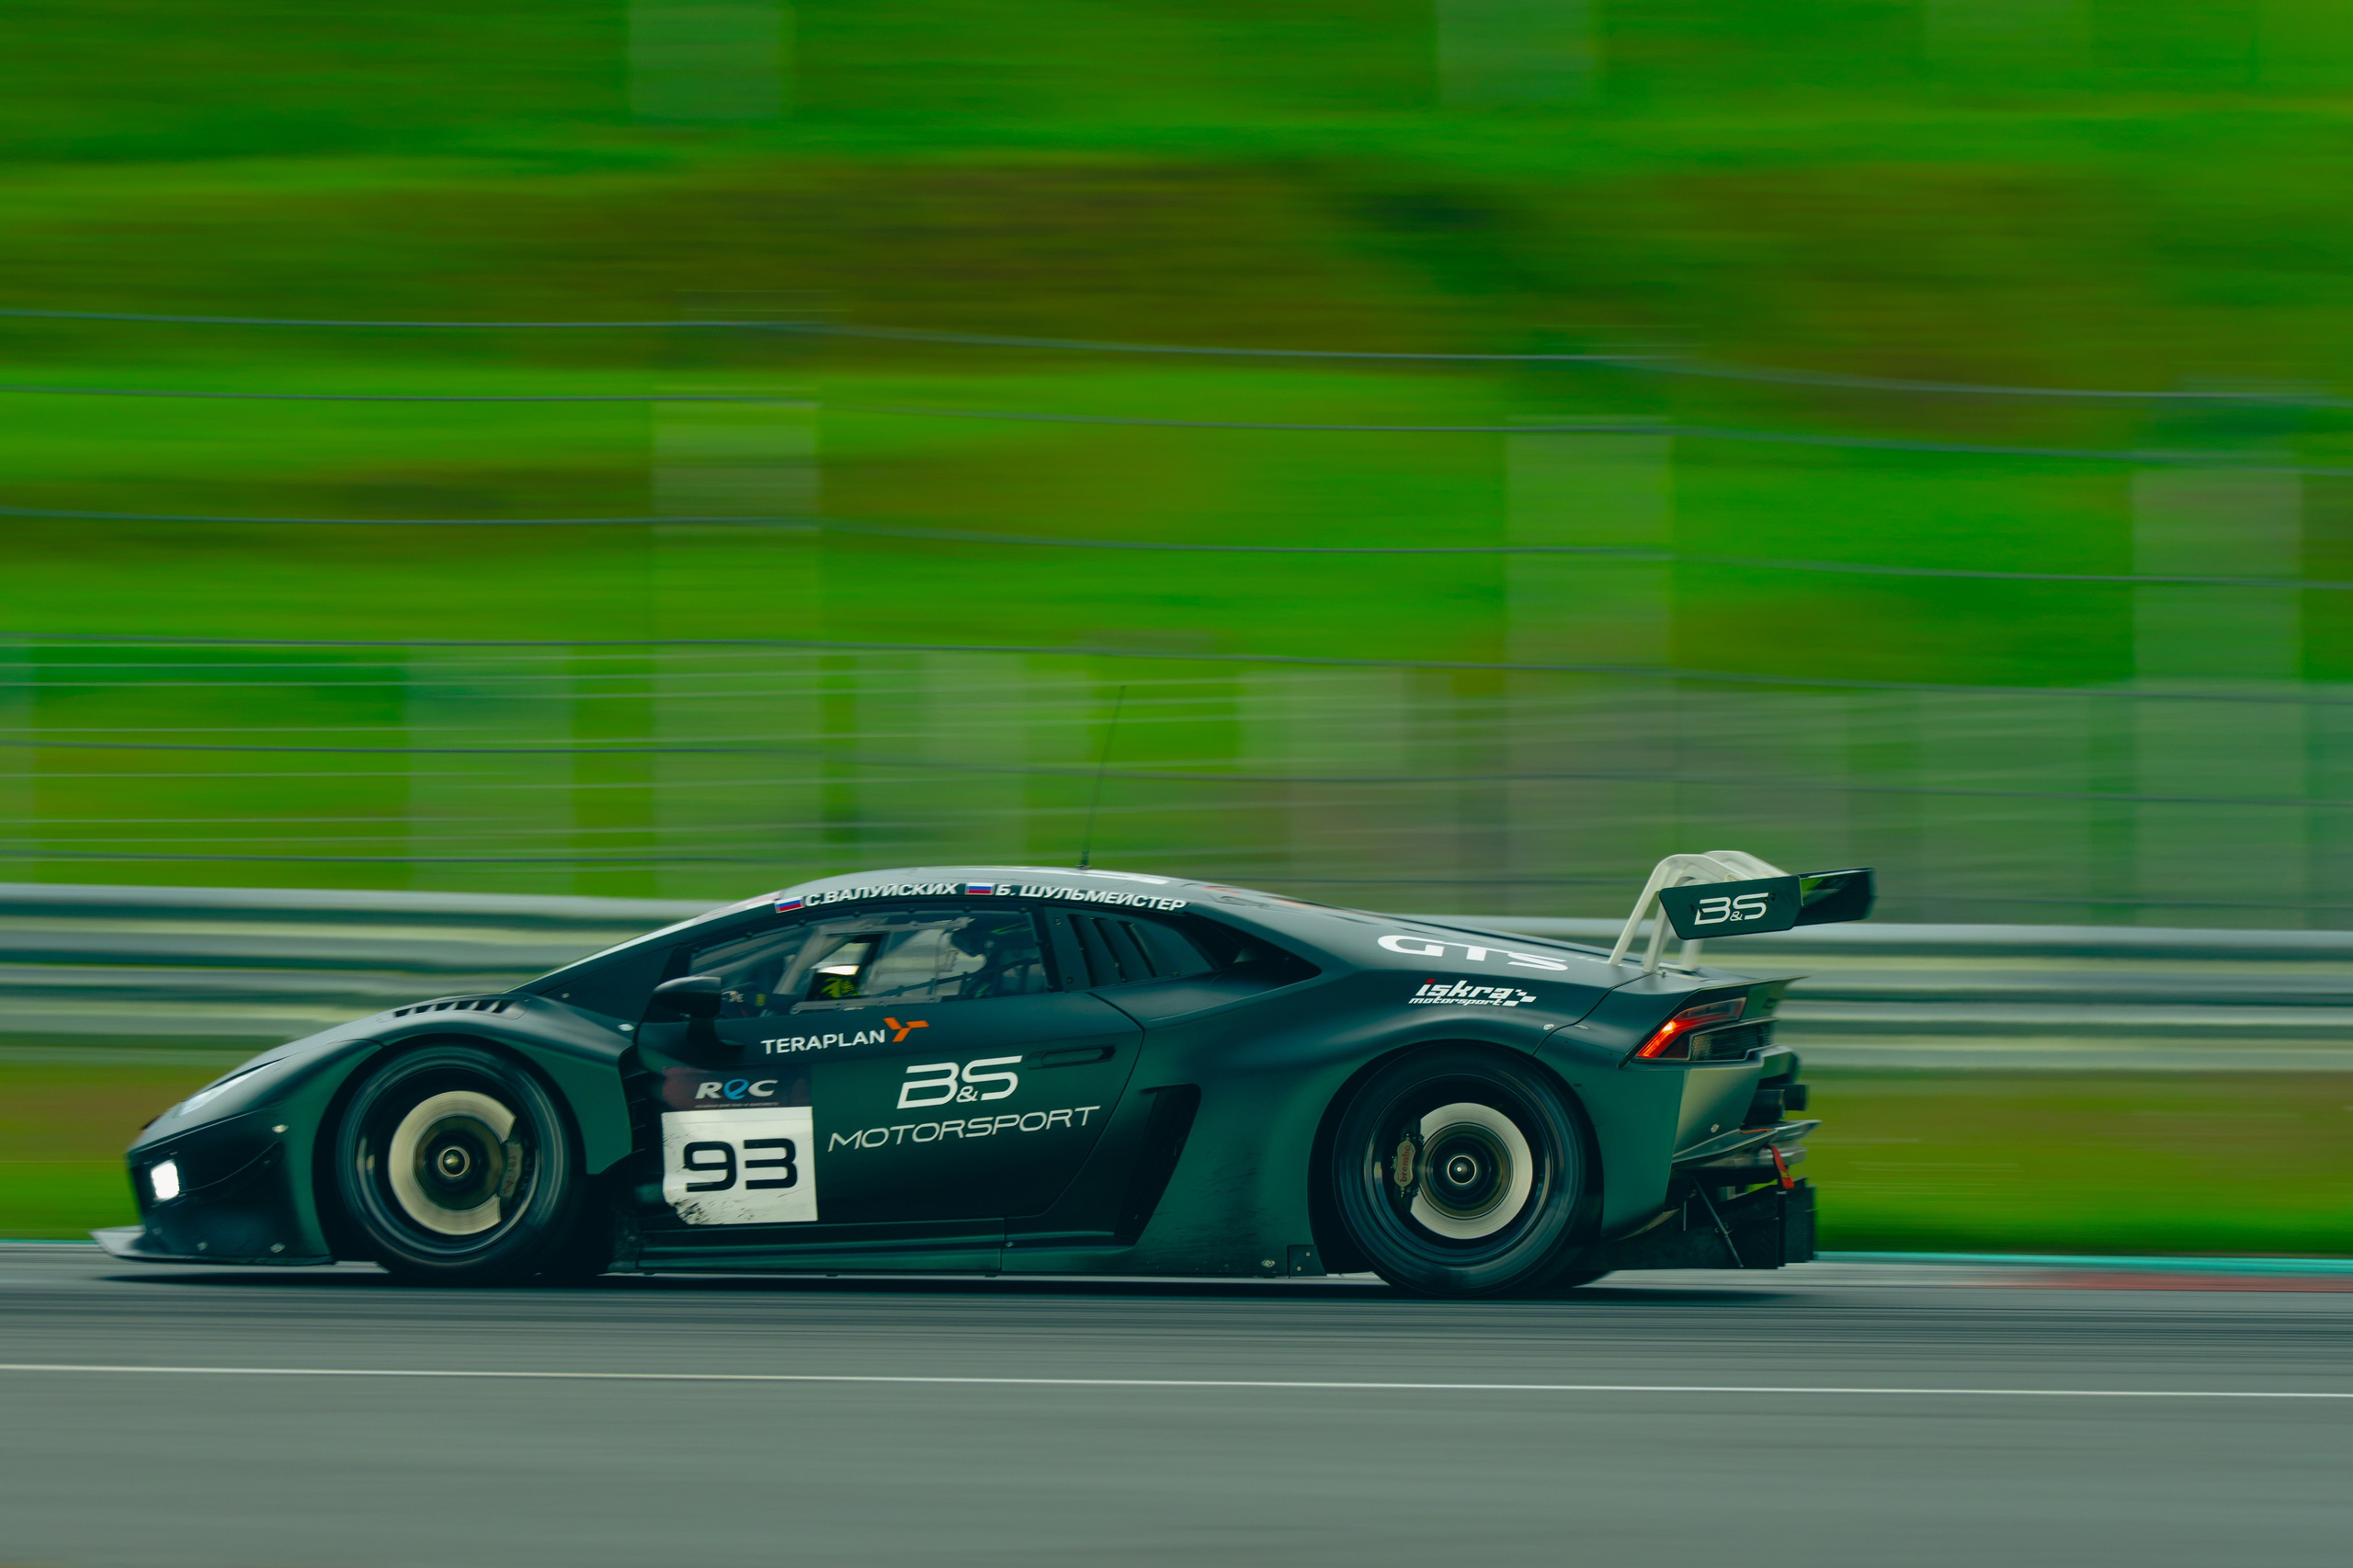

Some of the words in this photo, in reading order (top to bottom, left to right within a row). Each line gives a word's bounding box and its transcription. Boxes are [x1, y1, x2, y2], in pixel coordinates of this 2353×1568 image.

[995, 884, 1017, 896] Б.
[1694, 892, 1769, 926] B&S
[1408, 994, 1504, 1006] motorsport
[1415, 979, 1515, 999] iskra
[761, 1028, 886, 1054] TERAPLAN
[896, 1055, 1022, 1110] B&S
[828, 1106, 1101, 1152] MOTORSPORT
[682, 1137, 798, 1192] 93
